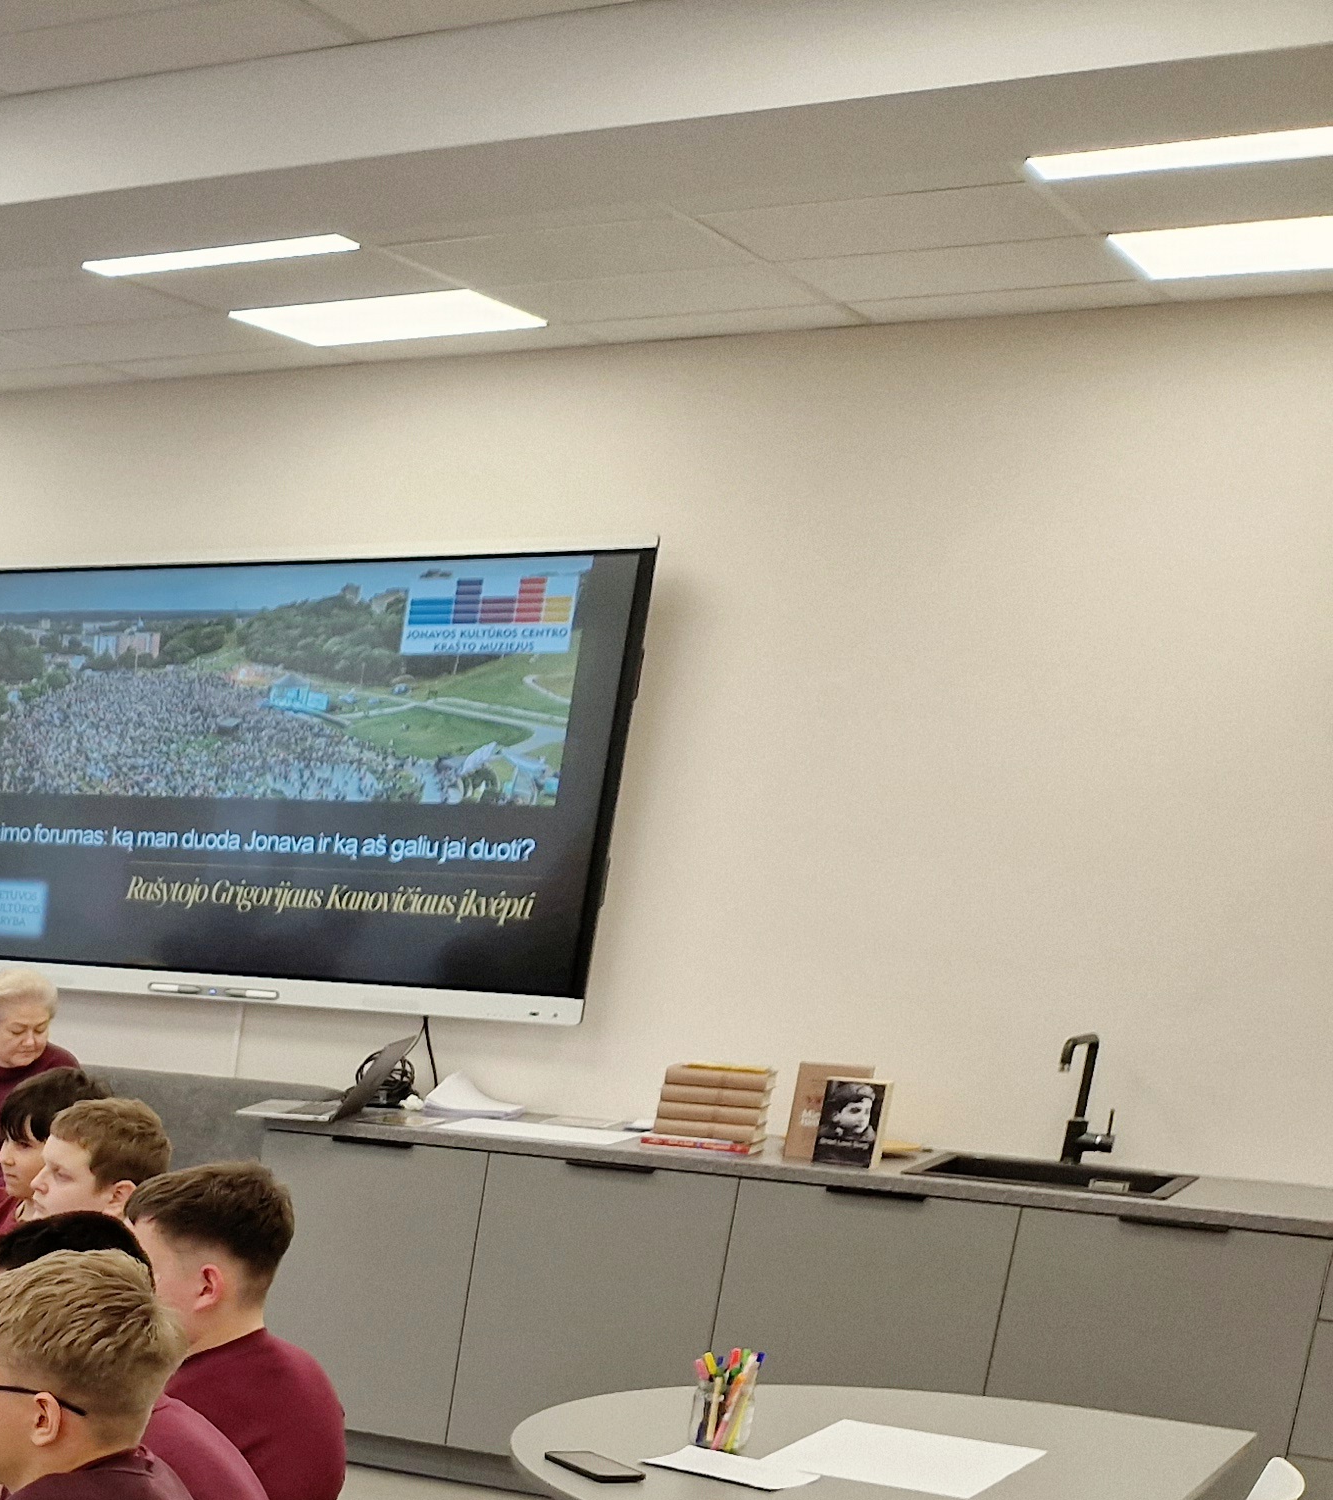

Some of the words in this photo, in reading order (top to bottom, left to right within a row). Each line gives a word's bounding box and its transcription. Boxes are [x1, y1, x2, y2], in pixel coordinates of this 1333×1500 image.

[406, 628, 456, 640] JONAVOS
[460, 626, 517, 639] KULTŪROS
[521, 628, 568, 638] CENTRO
[433, 639, 477, 651] KRAŠTO
[479, 641, 534, 652] MUZIEJUS
[33, 823, 109, 846] forumas:
[111, 826, 133, 852] ką
[137, 829, 181, 848] man
[182, 828, 241, 851] duoda
[244, 830, 315, 854] Jonava
[317, 832, 333, 853] ir
[333, 833, 358, 861] ką
[361, 834, 387, 857] aš
[390, 835, 438, 863] galiu
[437, 836, 467, 865] jai
[468, 838, 536, 862] duoti?
[125, 875, 209, 910] Rašytojo
[211, 879, 324, 915] Grigorijaus
[325, 882, 457, 917] Kanovičiaus
[456, 889, 536, 926] įkvėpti
